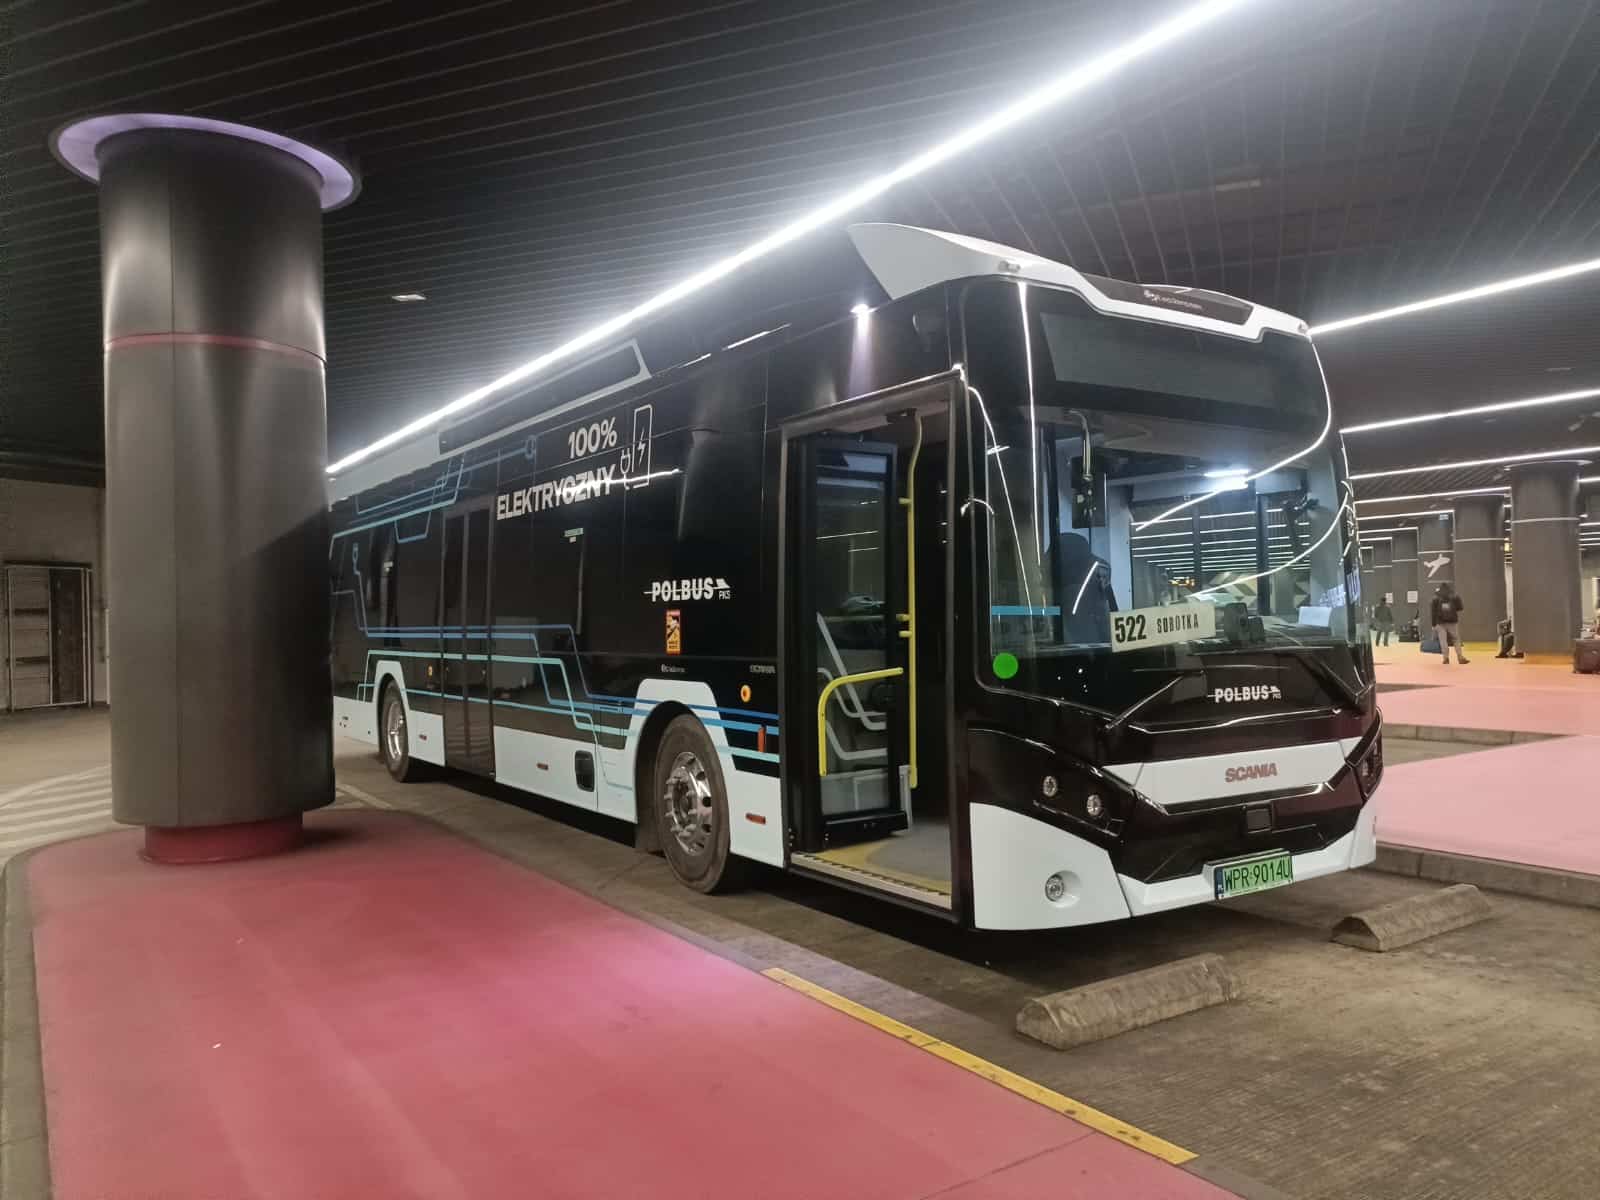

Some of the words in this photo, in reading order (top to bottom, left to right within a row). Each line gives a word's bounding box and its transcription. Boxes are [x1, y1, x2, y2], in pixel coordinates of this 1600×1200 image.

[568, 417, 618, 459] 100%
[497, 464, 616, 521] ELEKTRYCZNY
[652, 577, 714, 602] POLBUS
[1114, 614, 1147, 643] 522
[1214, 685, 1269, 703] POLBUS
[1225, 763, 1278, 783] SCANIA
[1224, 867, 1250, 891] WPR
[1253, 855, 1291, 886] 9014U
